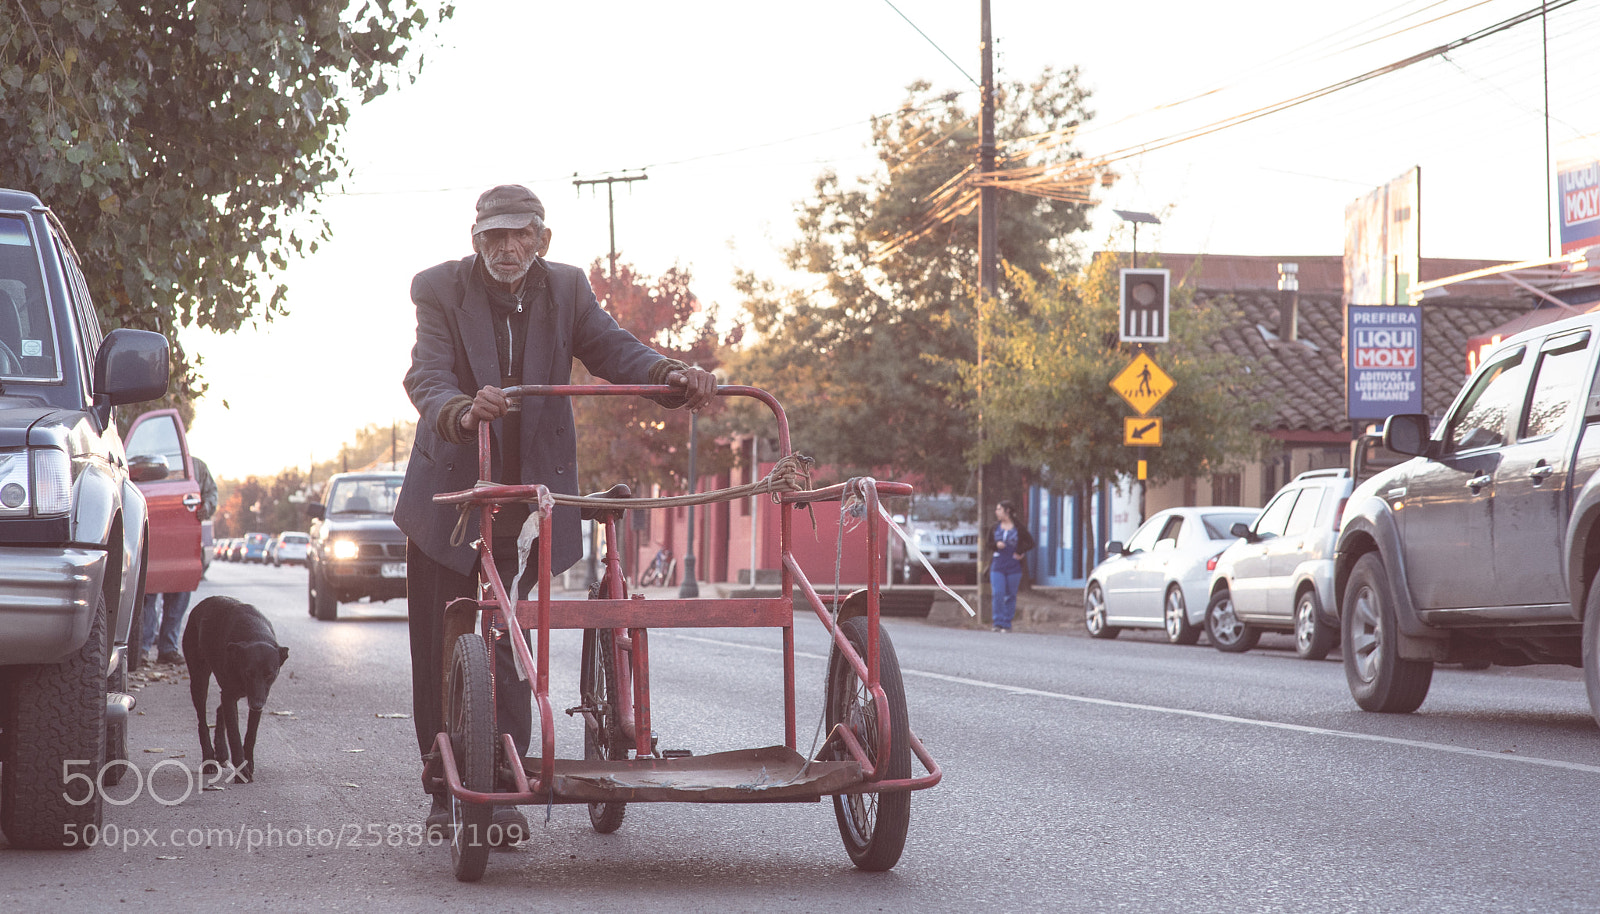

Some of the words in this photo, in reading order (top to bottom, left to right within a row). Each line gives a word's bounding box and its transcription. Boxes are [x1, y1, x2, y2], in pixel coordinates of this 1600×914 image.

[1566, 188, 1599, 221] MOLY
[1353, 312, 1417, 324] PREFIERA
[1358, 331, 1413, 348] LIQUI
[1358, 349, 1414, 366] MOLY
[1359, 371, 1403, 381] ADITIVOS
[1404, 371, 1411, 381] Y
[1355, 381, 1416, 392] LUBRICANTES
[1360, 391, 1410, 401] ALEMANES
